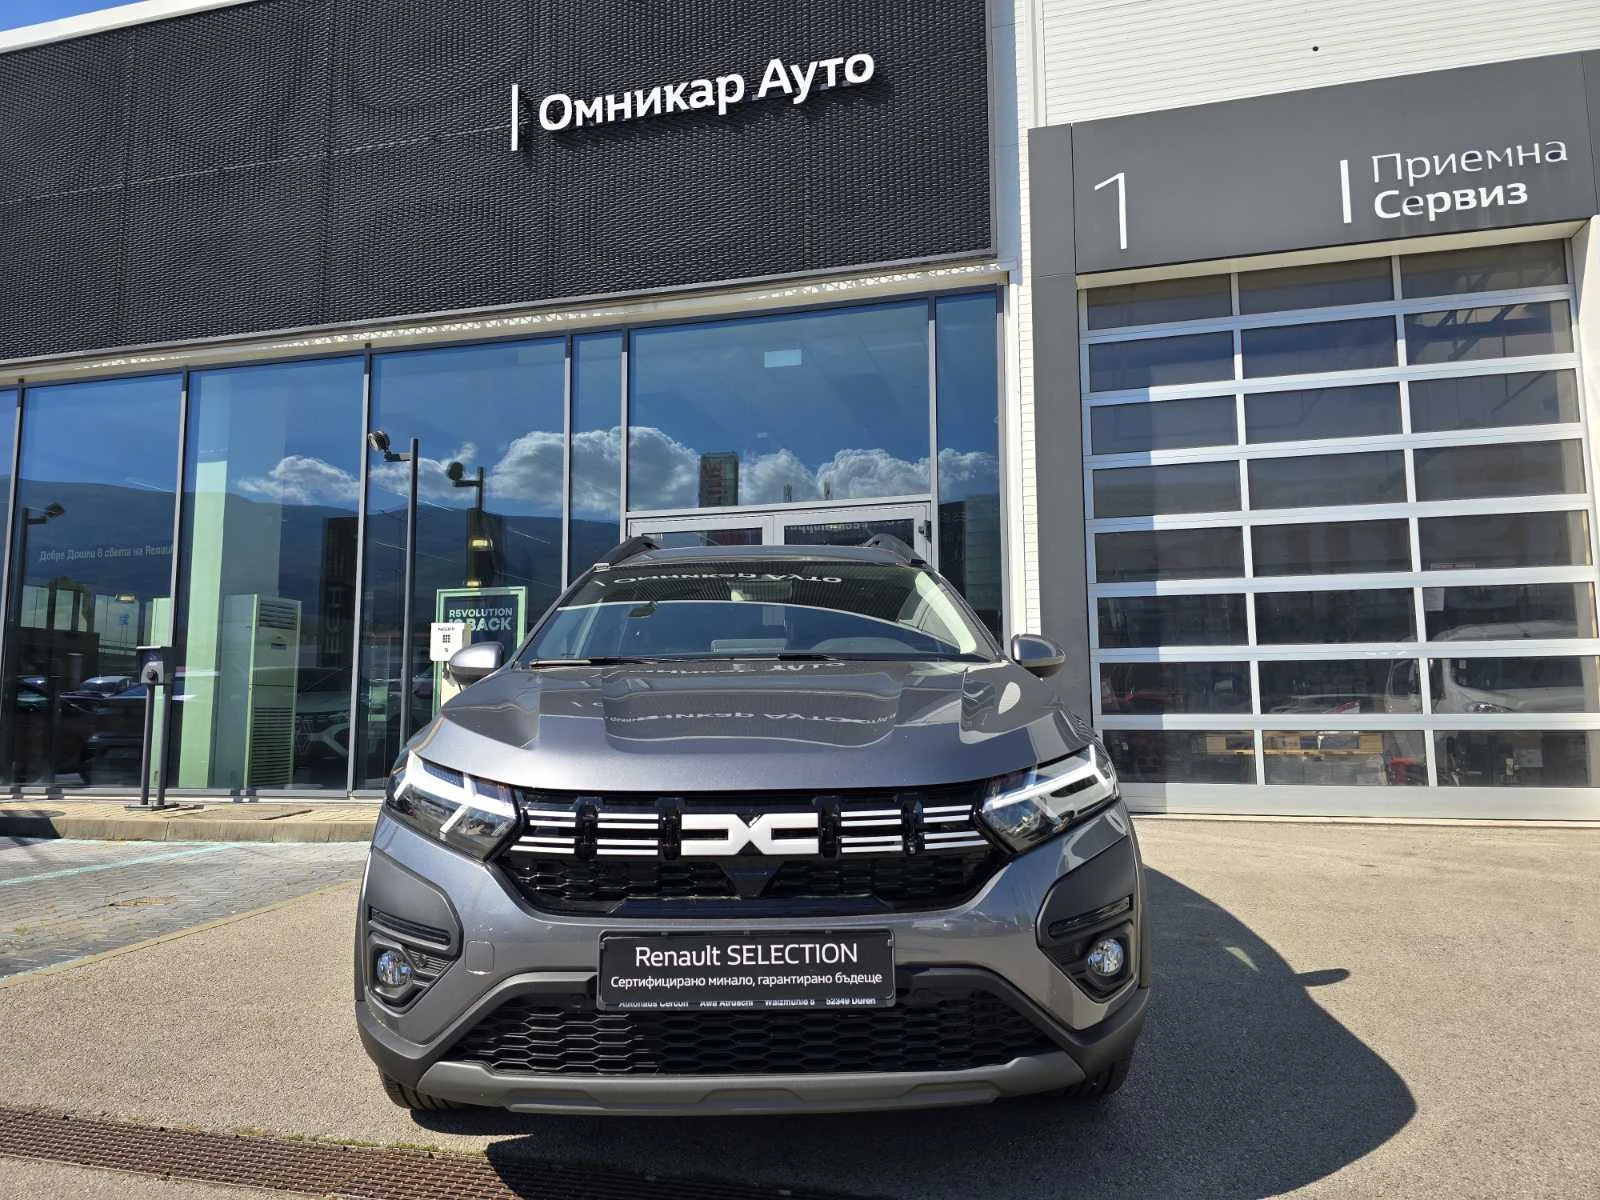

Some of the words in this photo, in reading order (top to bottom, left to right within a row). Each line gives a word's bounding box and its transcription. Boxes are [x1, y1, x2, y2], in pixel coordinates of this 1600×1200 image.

[539, 73, 745, 131] Омникар
[758, 52, 876, 105] Ауто
[1371, 140, 1568, 186] Приемна
[1094, 172, 1128, 250] 1
[1373, 180, 1528, 222] Сервиз
[448, 607, 513, 618] R5VOLUTION
[466, 617, 512, 631] BACK
[635, 945, 721, 967] Renault
[727, 943, 858, 965] SELECTION
[611, 975, 705, 990] Сертифицирано
[708, 976, 755, 987] минало,
[758, 974, 832, 987] гарантирано
[835, 971, 883, 986] бъдеще
